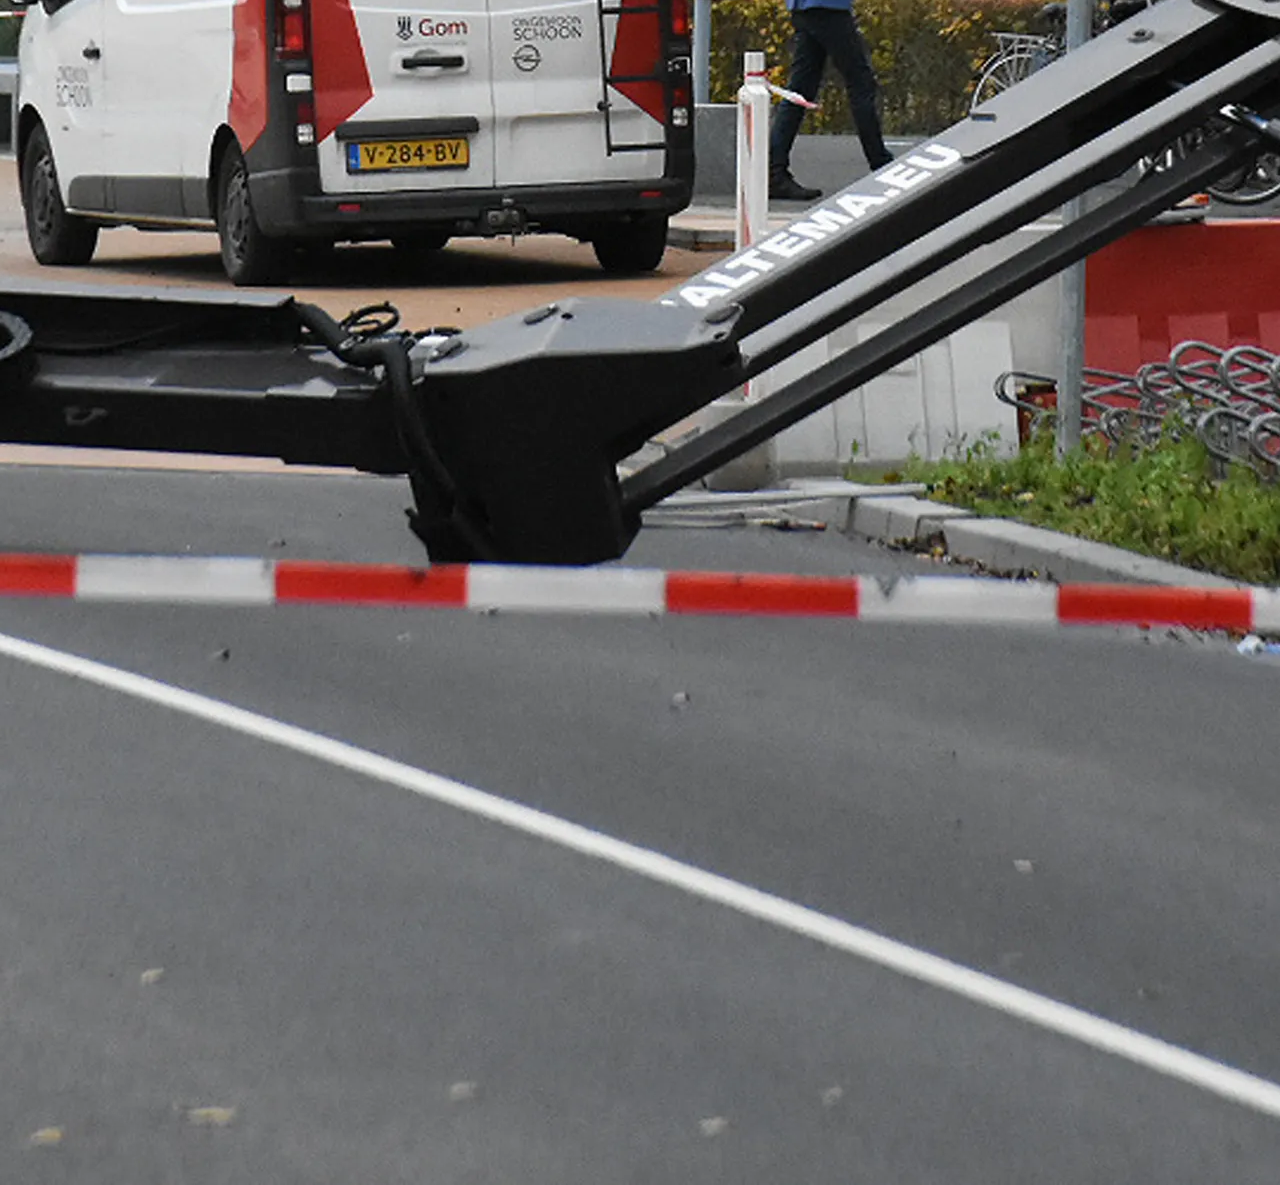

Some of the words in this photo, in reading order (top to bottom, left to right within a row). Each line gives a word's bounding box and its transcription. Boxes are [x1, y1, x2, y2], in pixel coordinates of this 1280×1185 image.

[418, 18, 468, 36] Gom
[513, 25, 582, 41] SCHOON
[364, 142, 461, 165] V-284-BV
[679, 143, 963, 309] ALTEMA.EU
